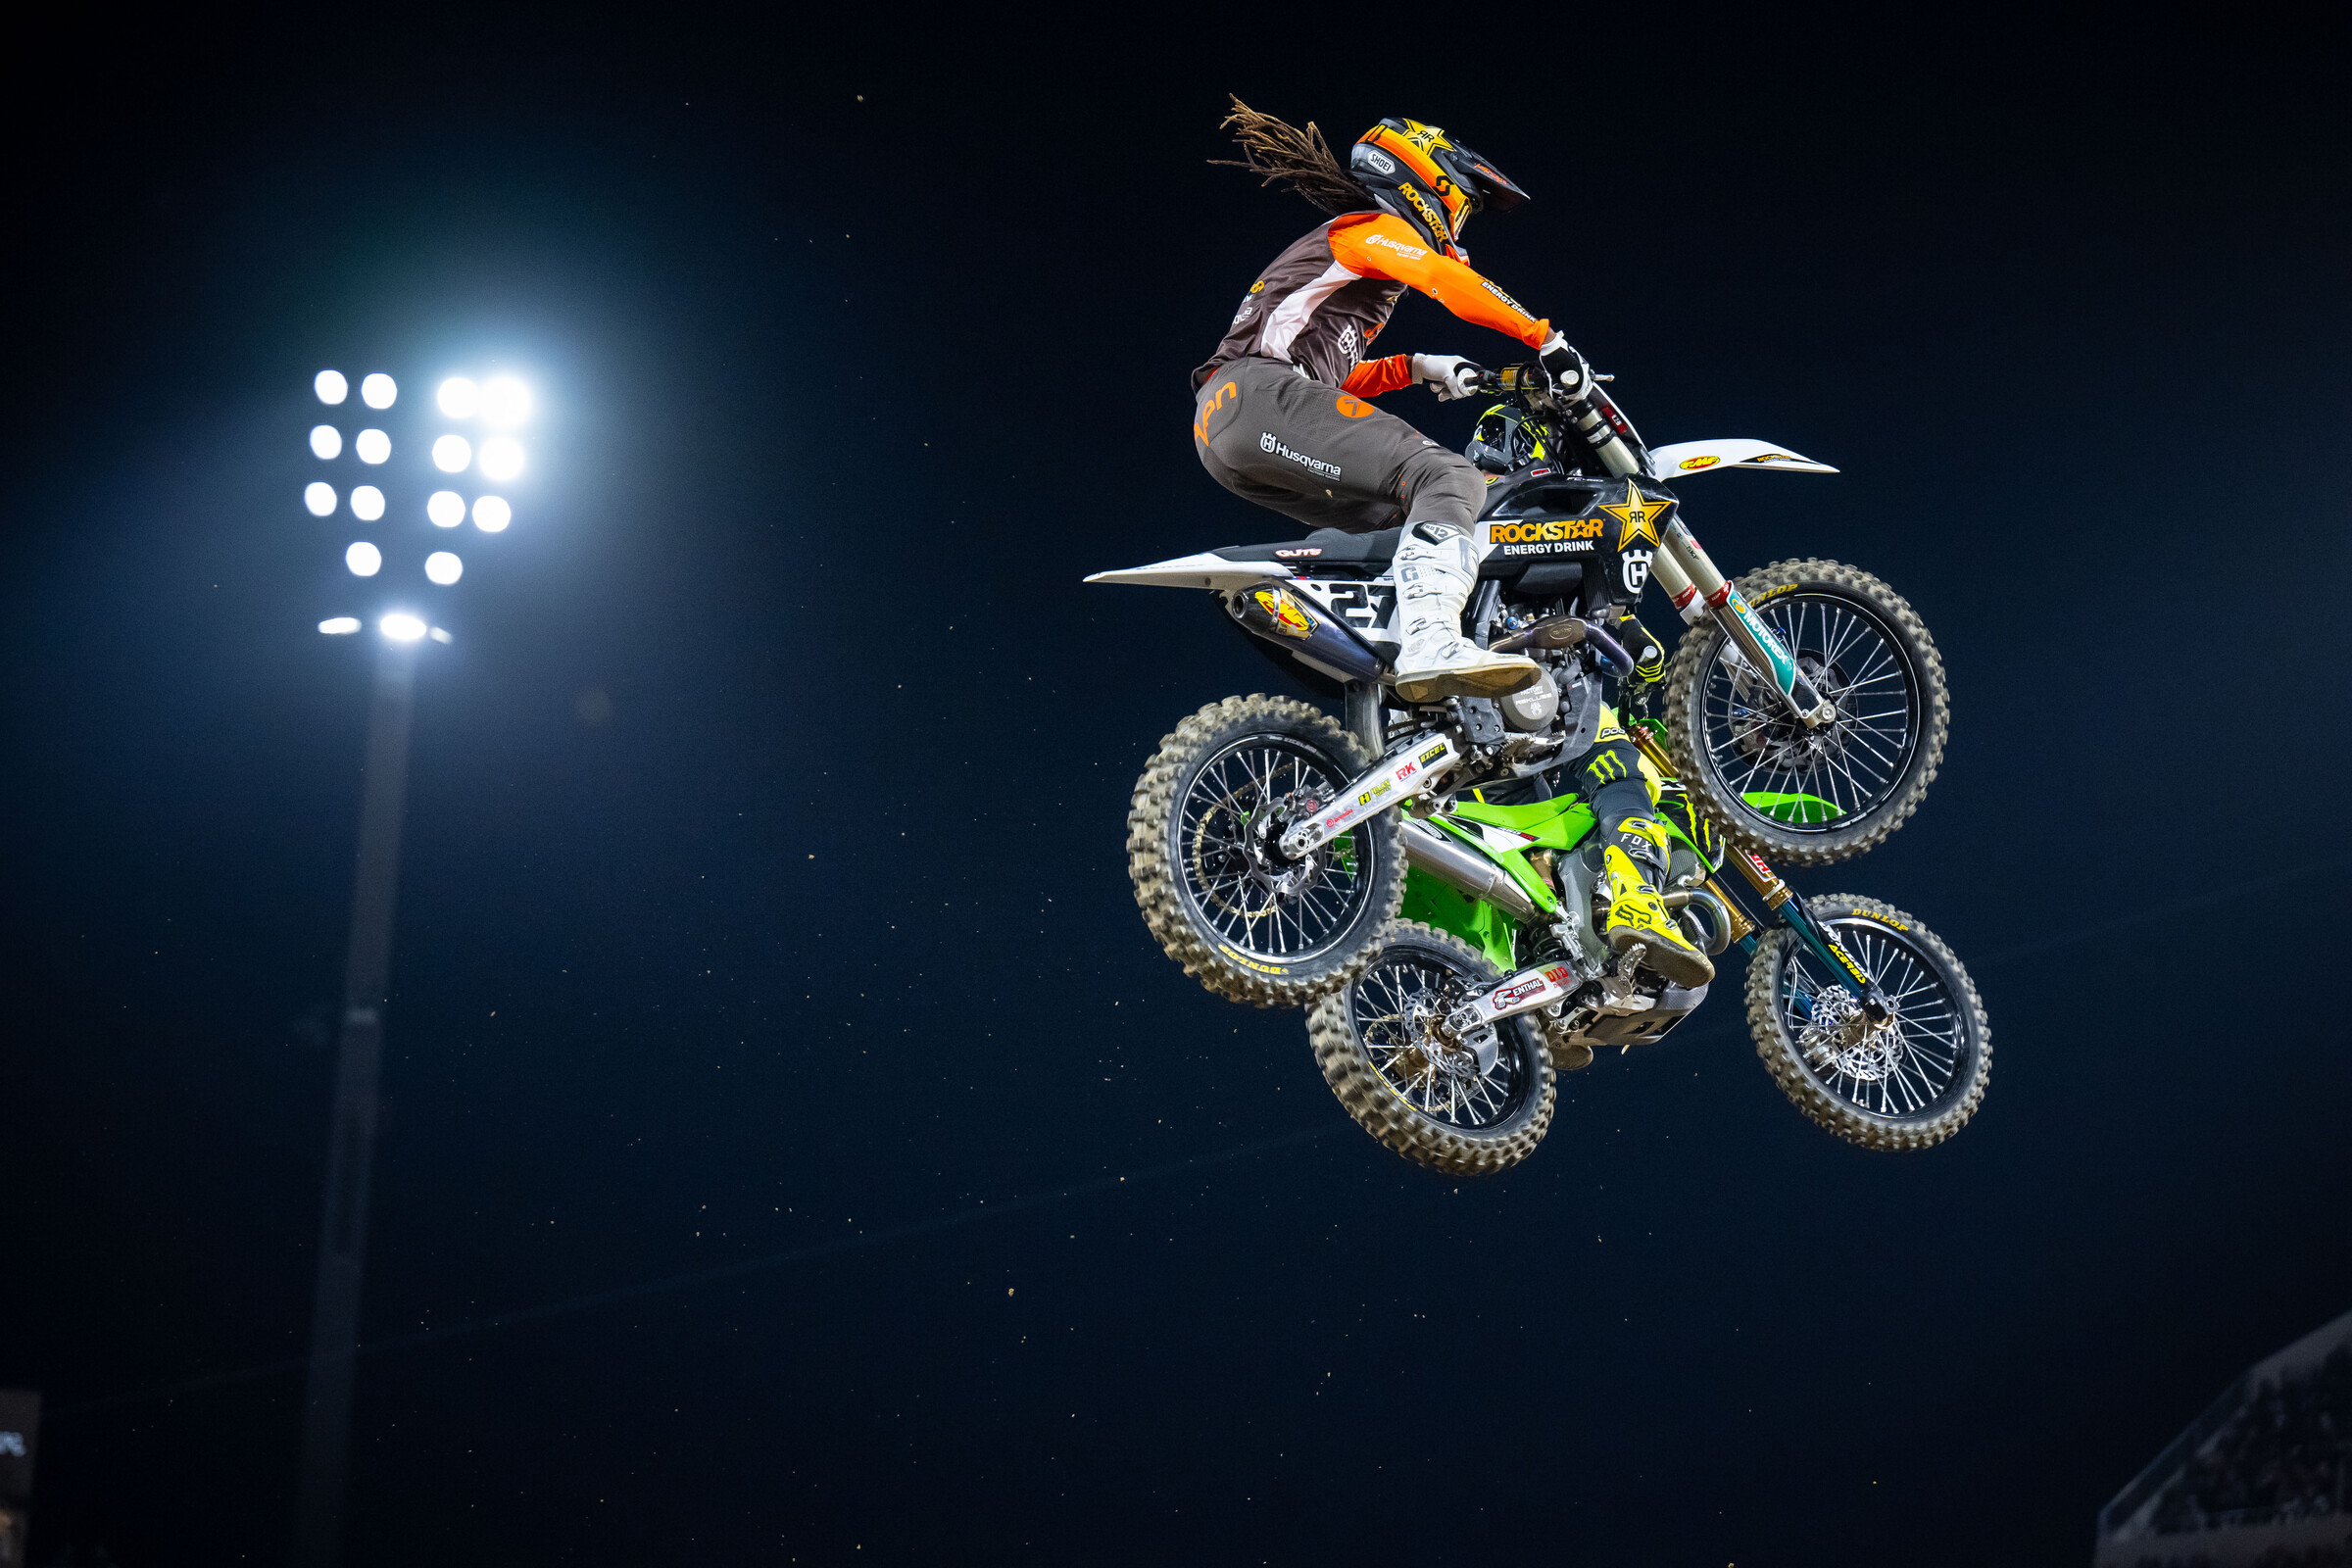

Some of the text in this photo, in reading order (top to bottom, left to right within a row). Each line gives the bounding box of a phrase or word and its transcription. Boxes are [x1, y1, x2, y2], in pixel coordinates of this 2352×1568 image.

[1370, 153, 1392, 172] SHOEI
[1397, 182, 1449, 242] ROCKSTAR
[1376, 236, 1428, 257] Husqvarna
[1481, 280, 1513, 305] ENERGY
[1510, 303, 1537, 323] DRINK
[1275, 441, 1342, 477] Husqvarna
[1682, 456, 1718, 469] FMF
[1490, 518, 1604, 544] ROCKSTAR
[1275, 548, 1322, 558] GUTS
[1503, 540, 1594, 556] ENERGY DRINK
[1329, 583, 1397, 629] 27
[1748, 584, 1798, 608] UNLOP
[1743, 610, 1788, 664] MOTOREX
[1419, 744, 1446, 763] EXCEL
[1396, 761, 1416, 780] RK
[1620, 833, 1652, 851] FOX
[1851, 907, 1909, 931] DUNLOP
[1218, 944, 1282, 975] DUNLOP
[1828, 944, 1866, 984] ACERBIS
